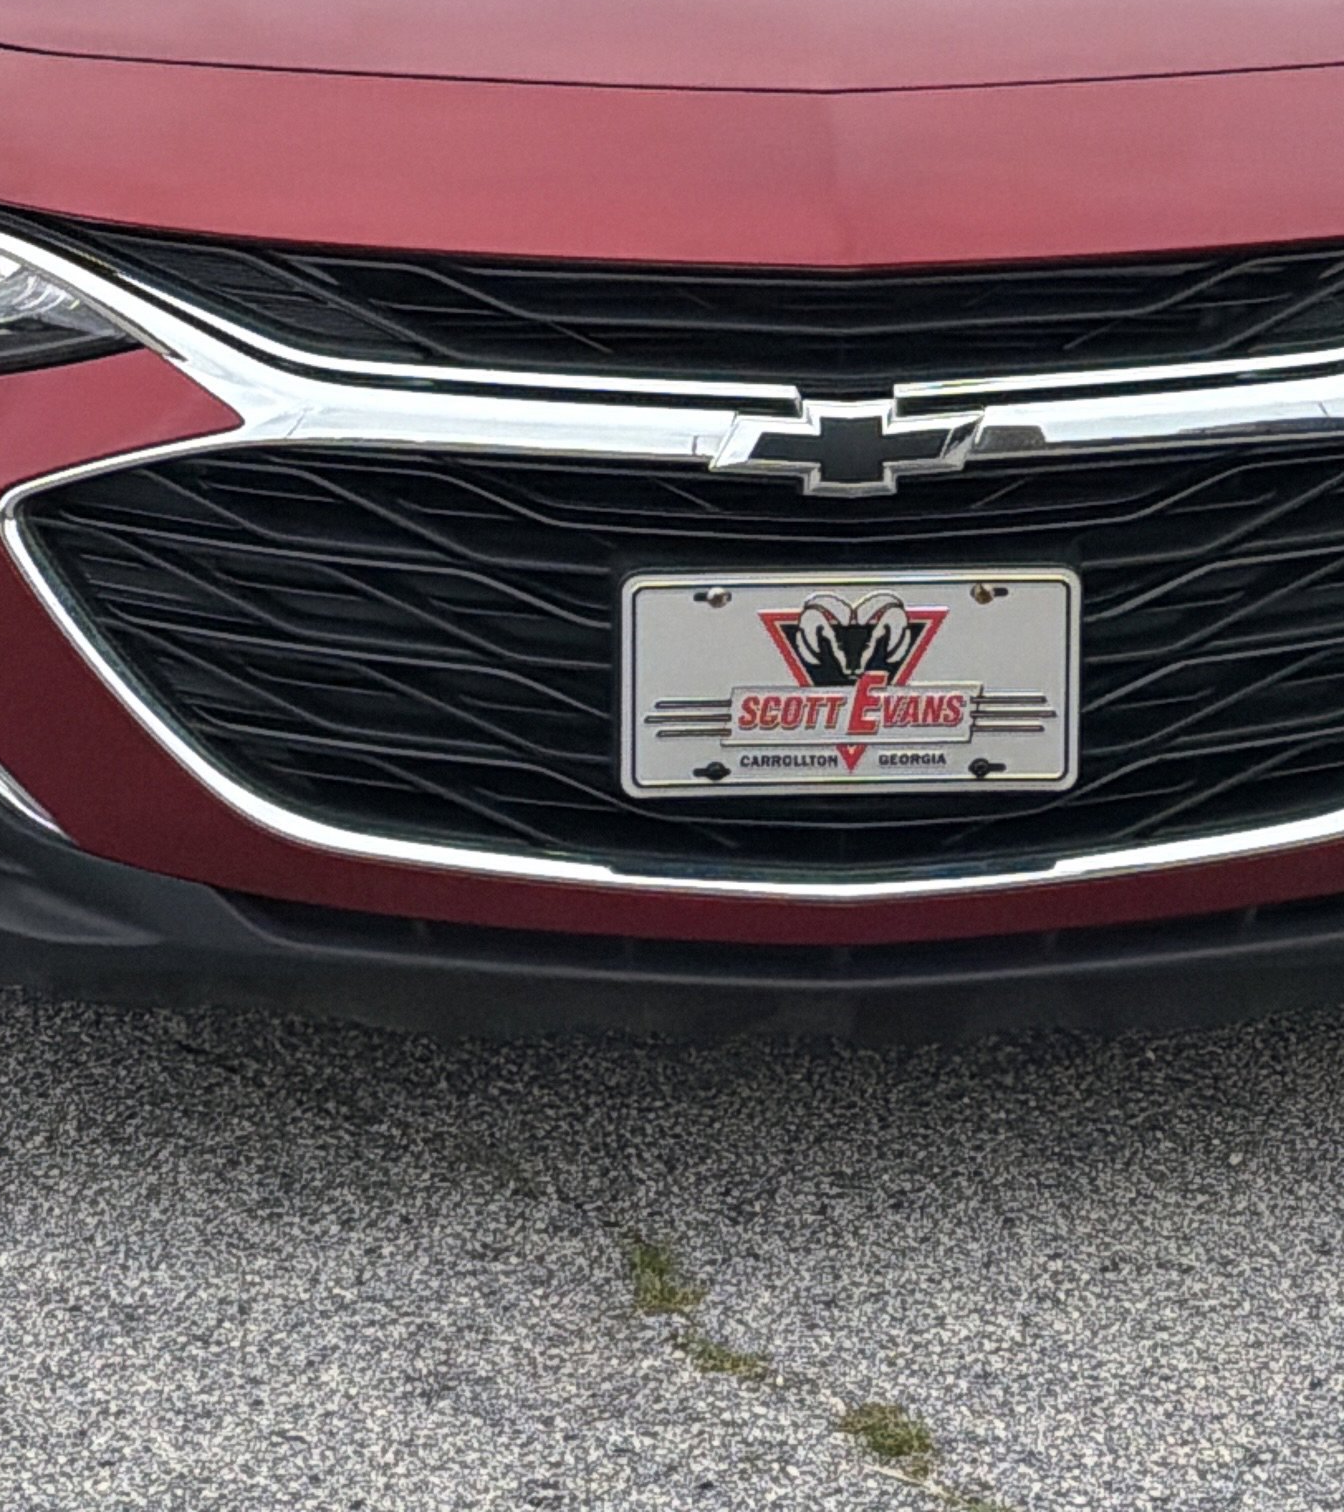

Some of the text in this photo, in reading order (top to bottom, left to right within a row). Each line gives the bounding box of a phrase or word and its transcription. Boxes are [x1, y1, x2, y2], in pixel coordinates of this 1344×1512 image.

[738, 671, 967, 735] SCOTT EVANS
[739, 752, 947, 768] CARROLLTON GEORGIA
